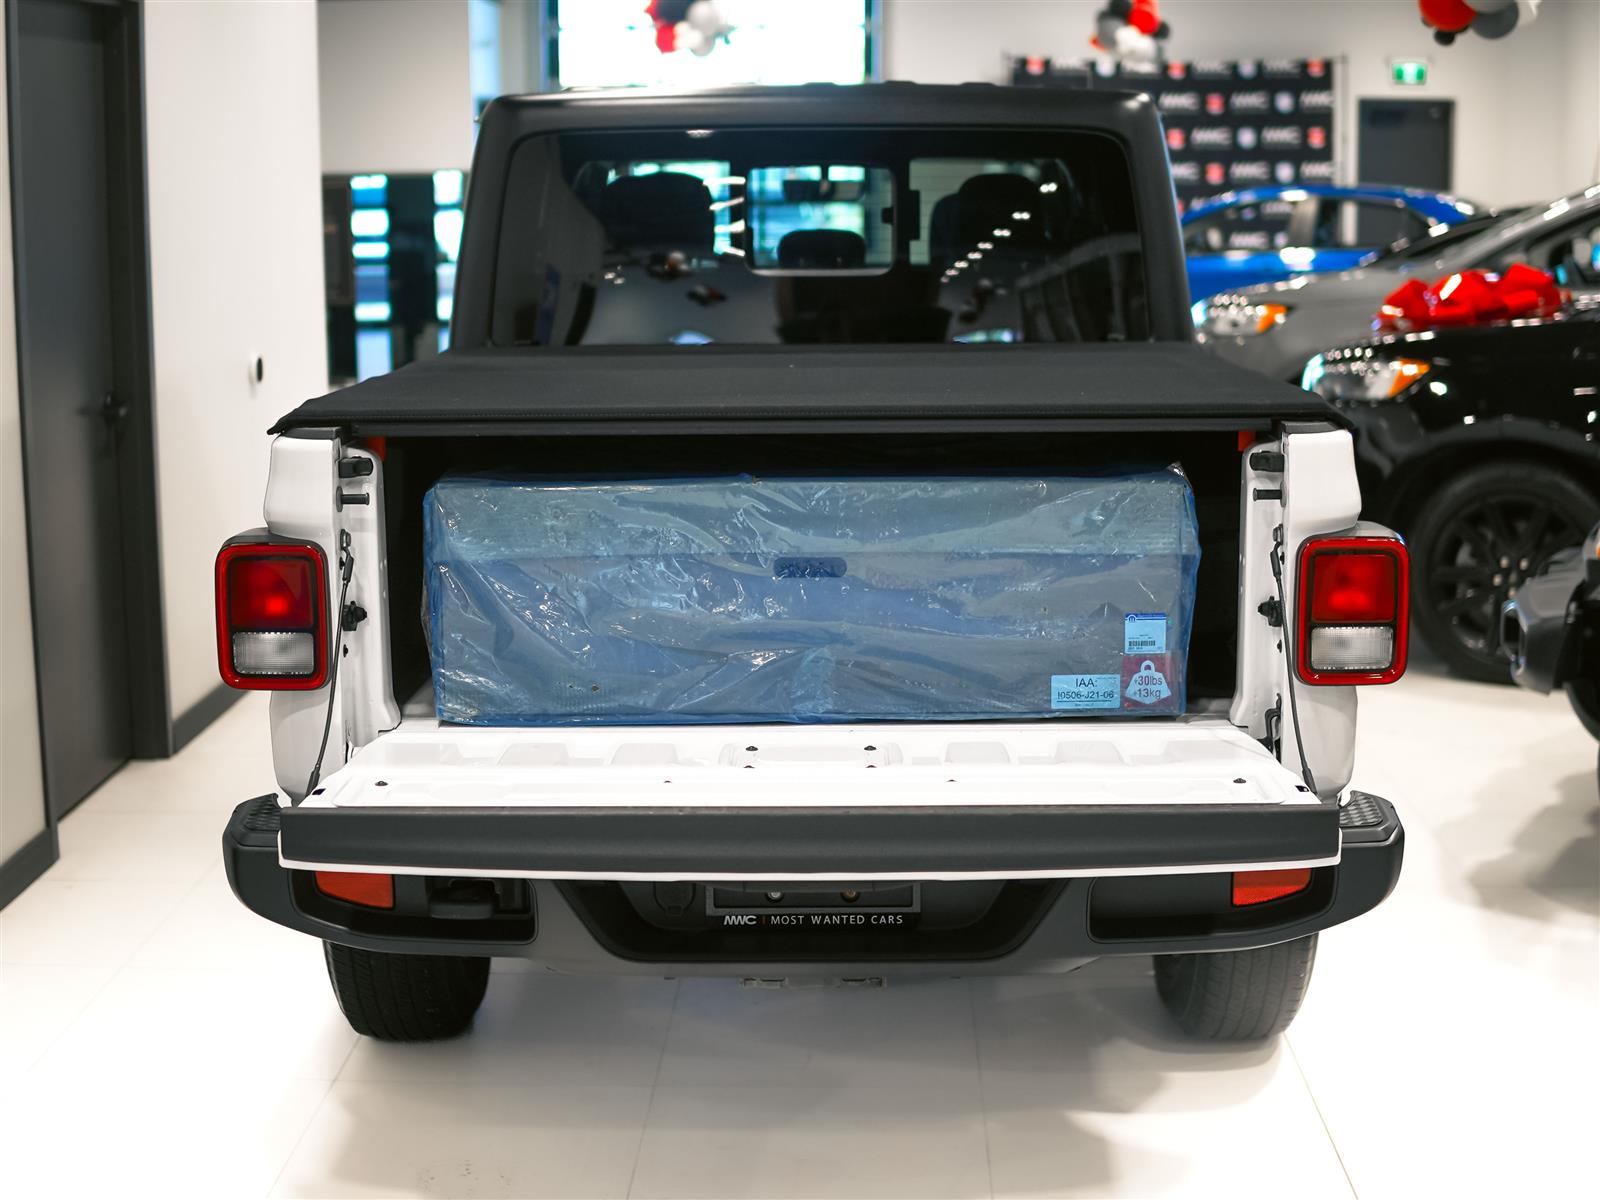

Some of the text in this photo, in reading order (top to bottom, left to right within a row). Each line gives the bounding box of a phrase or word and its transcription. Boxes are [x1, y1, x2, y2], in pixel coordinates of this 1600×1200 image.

[1075, 678, 1098, 688] IAA:
[770, 915, 805, 925] MOST
[811, 915, 865, 925] WANTED
[870, 915, 903, 925] CARS
